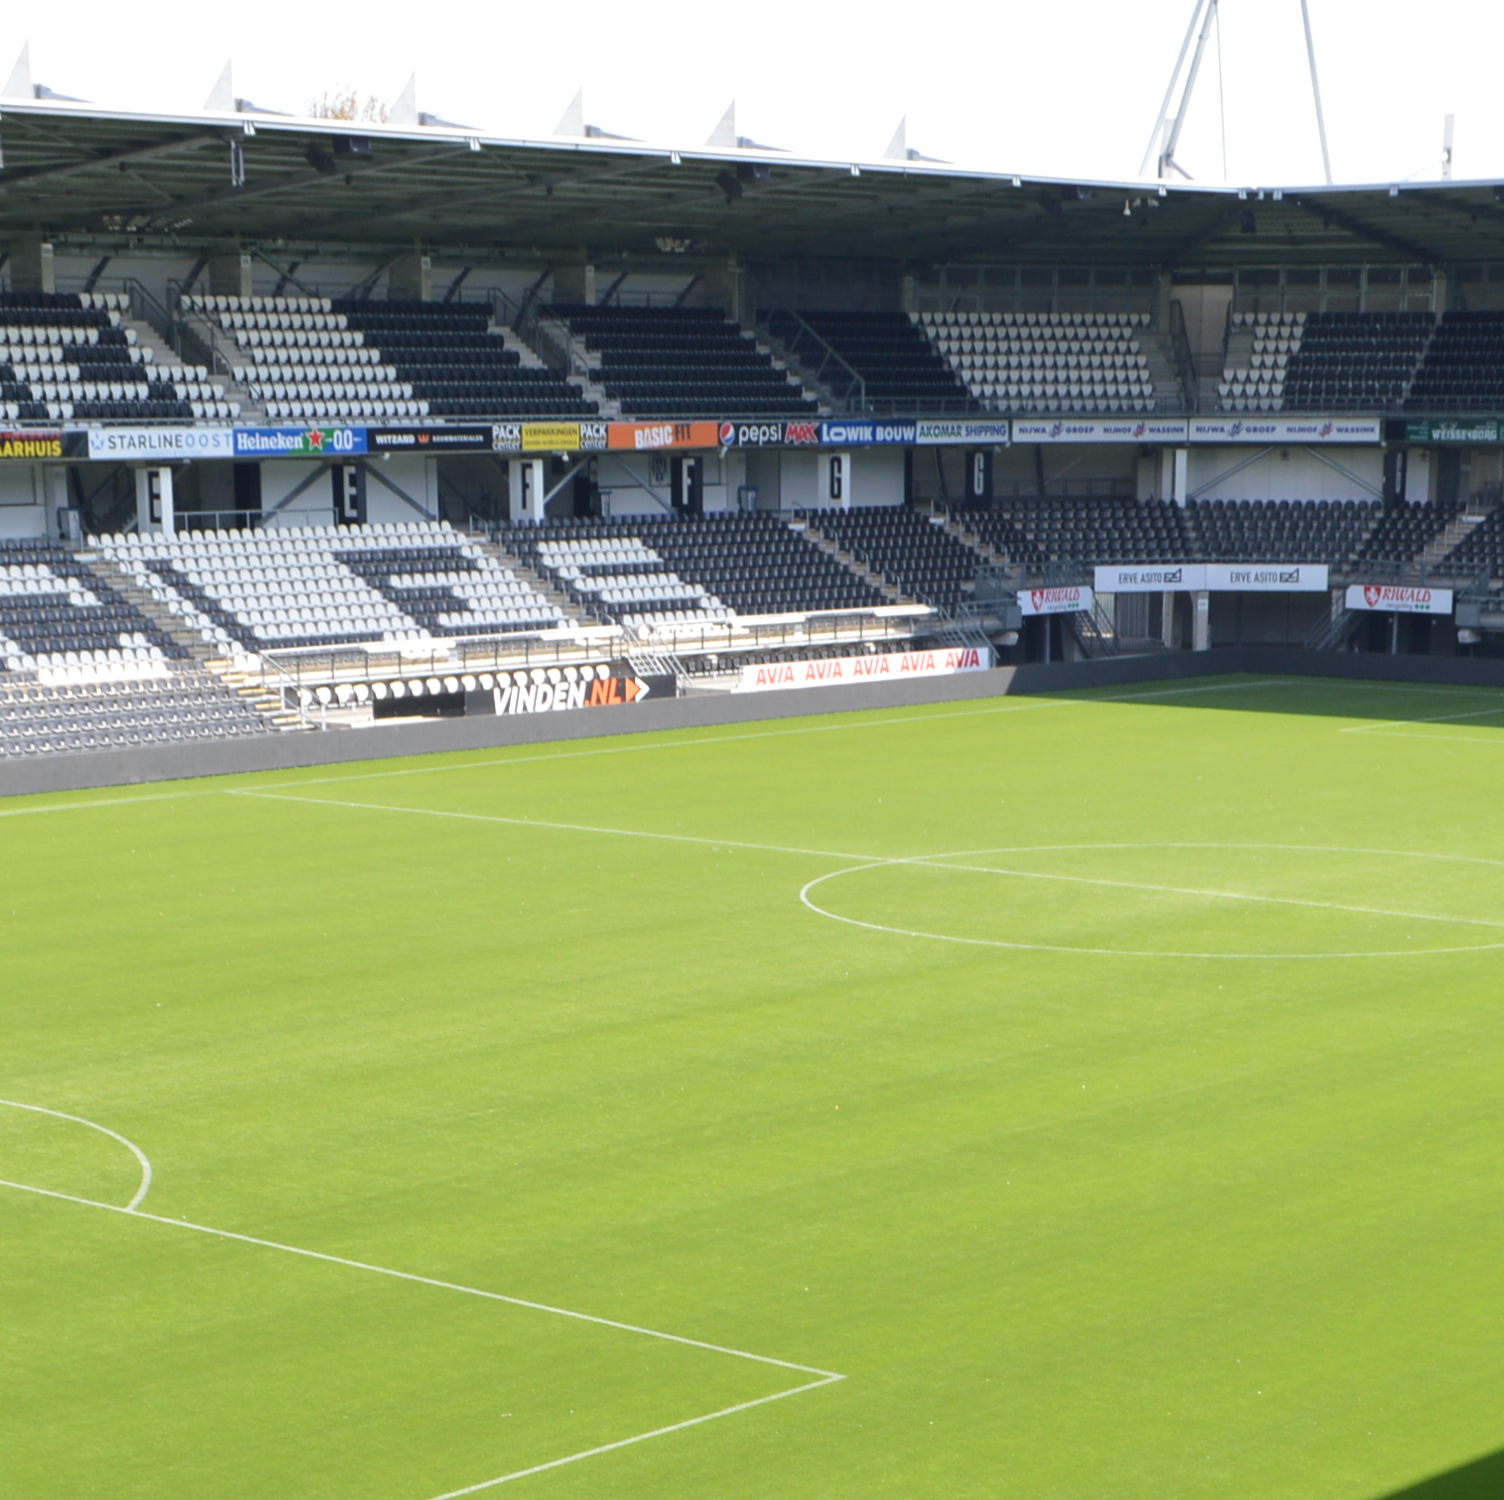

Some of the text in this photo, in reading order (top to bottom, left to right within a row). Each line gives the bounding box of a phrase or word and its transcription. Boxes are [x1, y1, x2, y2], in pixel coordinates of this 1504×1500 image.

[375, 433, 416, 445] WITZAND
[492, 424, 522, 440] PACK
[580, 424, 607, 439] PACK
[738, 423, 820, 446] pepsi MAX
[875, 424, 916, 442] BOUW
[918, 423, 1007, 439] AKOMAR SHIPPING
[1065, 426, 1095, 435] GROEP
[1148, 426, 1186, 435] WASSINK
[1245, 426, 1277, 434] GROEP
[1335, 426, 1376, 434] WASSINK
[236, 432, 304, 450] Heineken
[492, 439, 522, 451] center
[580, 438, 607, 449] center
[682, 458, 695, 505] F
[829, 455, 842, 499] G
[972, 452, 984, 496] G
[342, 465, 357, 518] E
[521, 462, 533, 510] F
[1118, 571, 1162, 584] ERVE ASITO
[1229, 571, 1278, 583] ERVE ASITO
[852, 656, 890, 676] AVIA
[899, 653, 936, 673] AVIA
[945, 648, 982, 668] AVIA
[756, 664, 794, 685] AVIA
[804, 660, 843, 681] AVIA
[492, 677, 623, 716] VINDEN.NL
